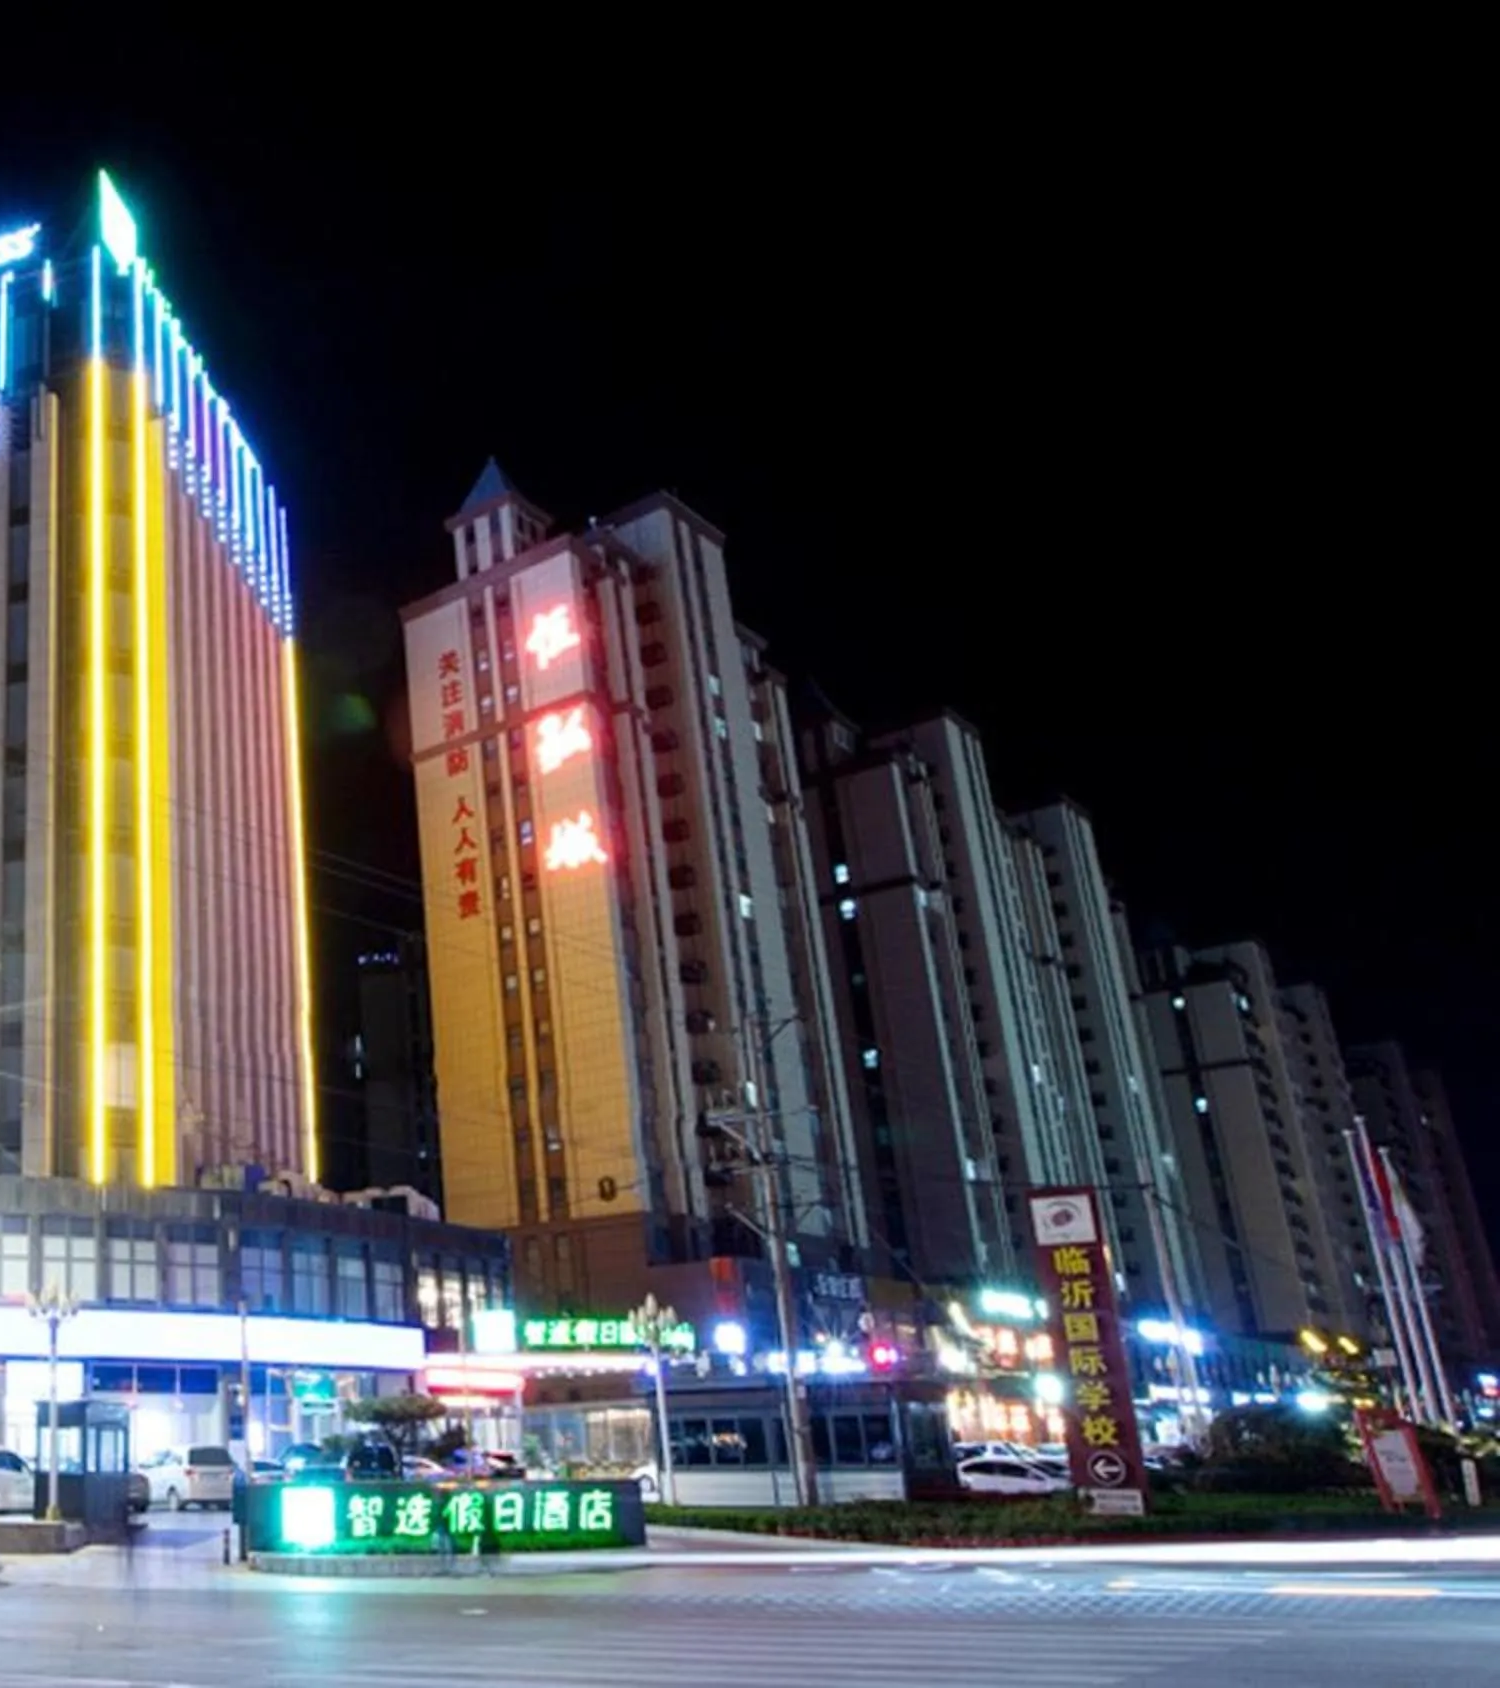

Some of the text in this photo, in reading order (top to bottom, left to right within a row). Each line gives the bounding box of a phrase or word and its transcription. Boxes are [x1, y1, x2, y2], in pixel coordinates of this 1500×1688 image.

[438, 650, 482, 919] 关注消防 人人有责
[1053, 1246, 1119, 1446] 临沂国际学校
[346, 1489, 613, 1537] 智选假日酒店
